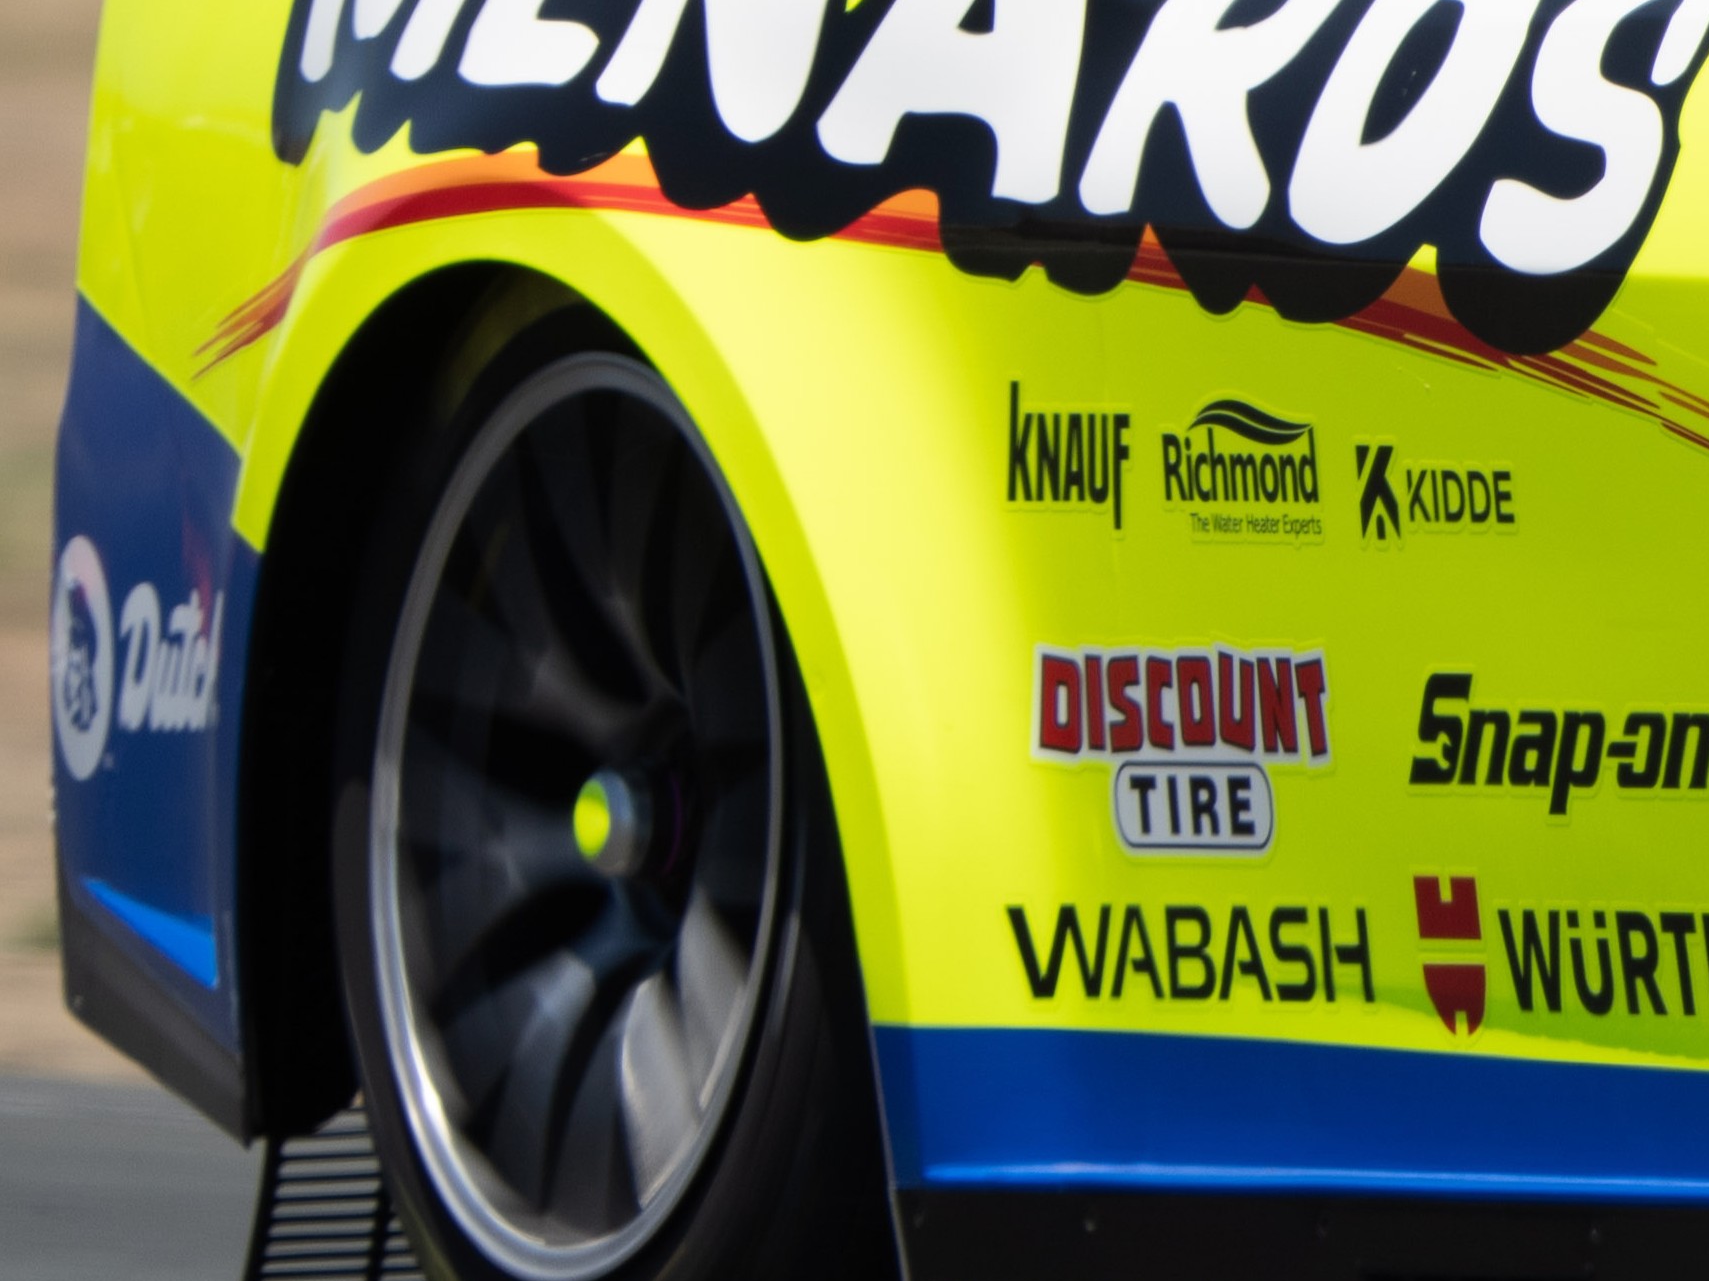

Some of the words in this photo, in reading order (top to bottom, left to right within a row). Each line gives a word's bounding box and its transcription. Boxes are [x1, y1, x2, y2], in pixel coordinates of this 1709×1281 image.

[1161, 426, 1320, 504] Richmond
[1406, 468, 1516, 524] KIDDE
[1190, 512, 1210, 533] The
[1212, 513, 1243, 533] Water
[1246, 513, 1280, 534] Heater
[1282, 514, 1323, 540] Experts
[1038, 650, 1329, 757] DISCOUNT
[1129, 774, 1256, 837] TIRE
[1006, 905, 1376, 1003] WABASH
